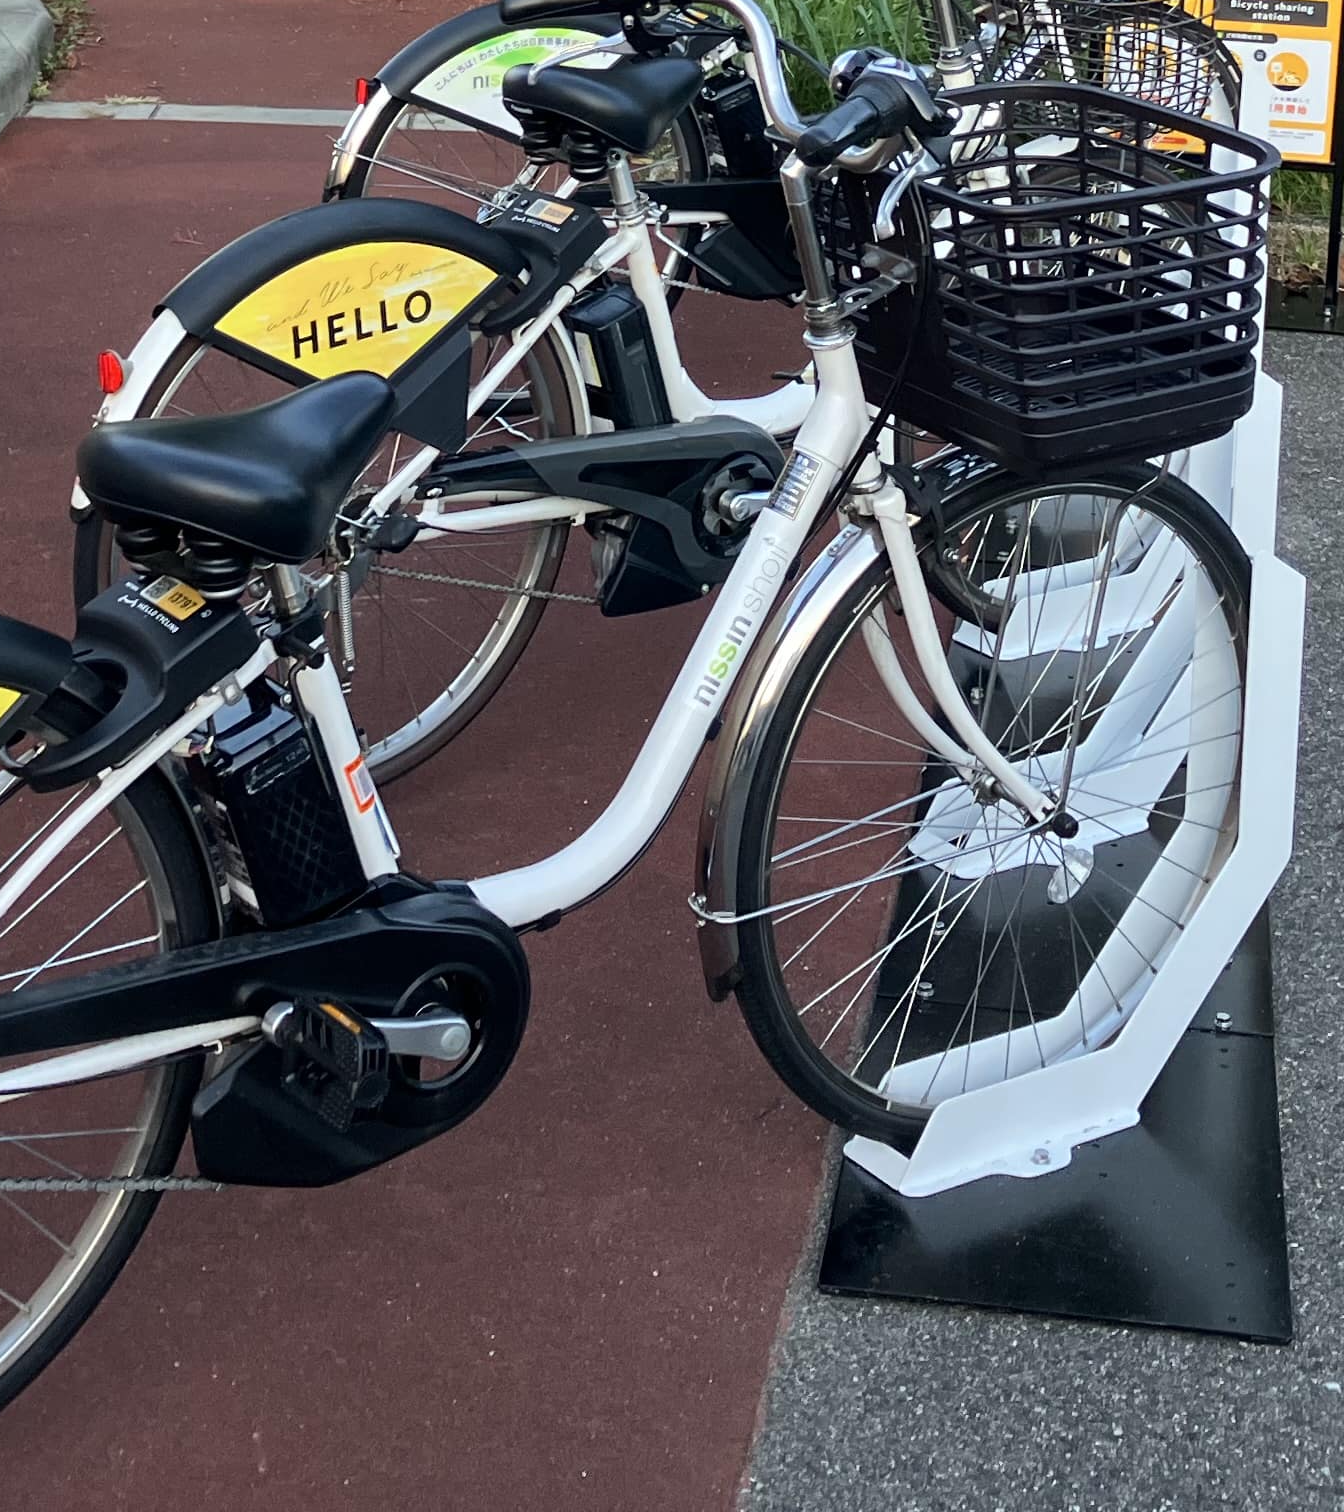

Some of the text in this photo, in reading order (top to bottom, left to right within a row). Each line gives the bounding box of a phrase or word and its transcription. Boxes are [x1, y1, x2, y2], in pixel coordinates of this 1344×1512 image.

[1230, 0, 1315, 15] Bicycle sharing
[1251, 11, 1291, 22] station
[291, 289, 433, 359] HELLO
[167, 591, 197, 612] 13797
[693, 615, 753, 707] nissin
